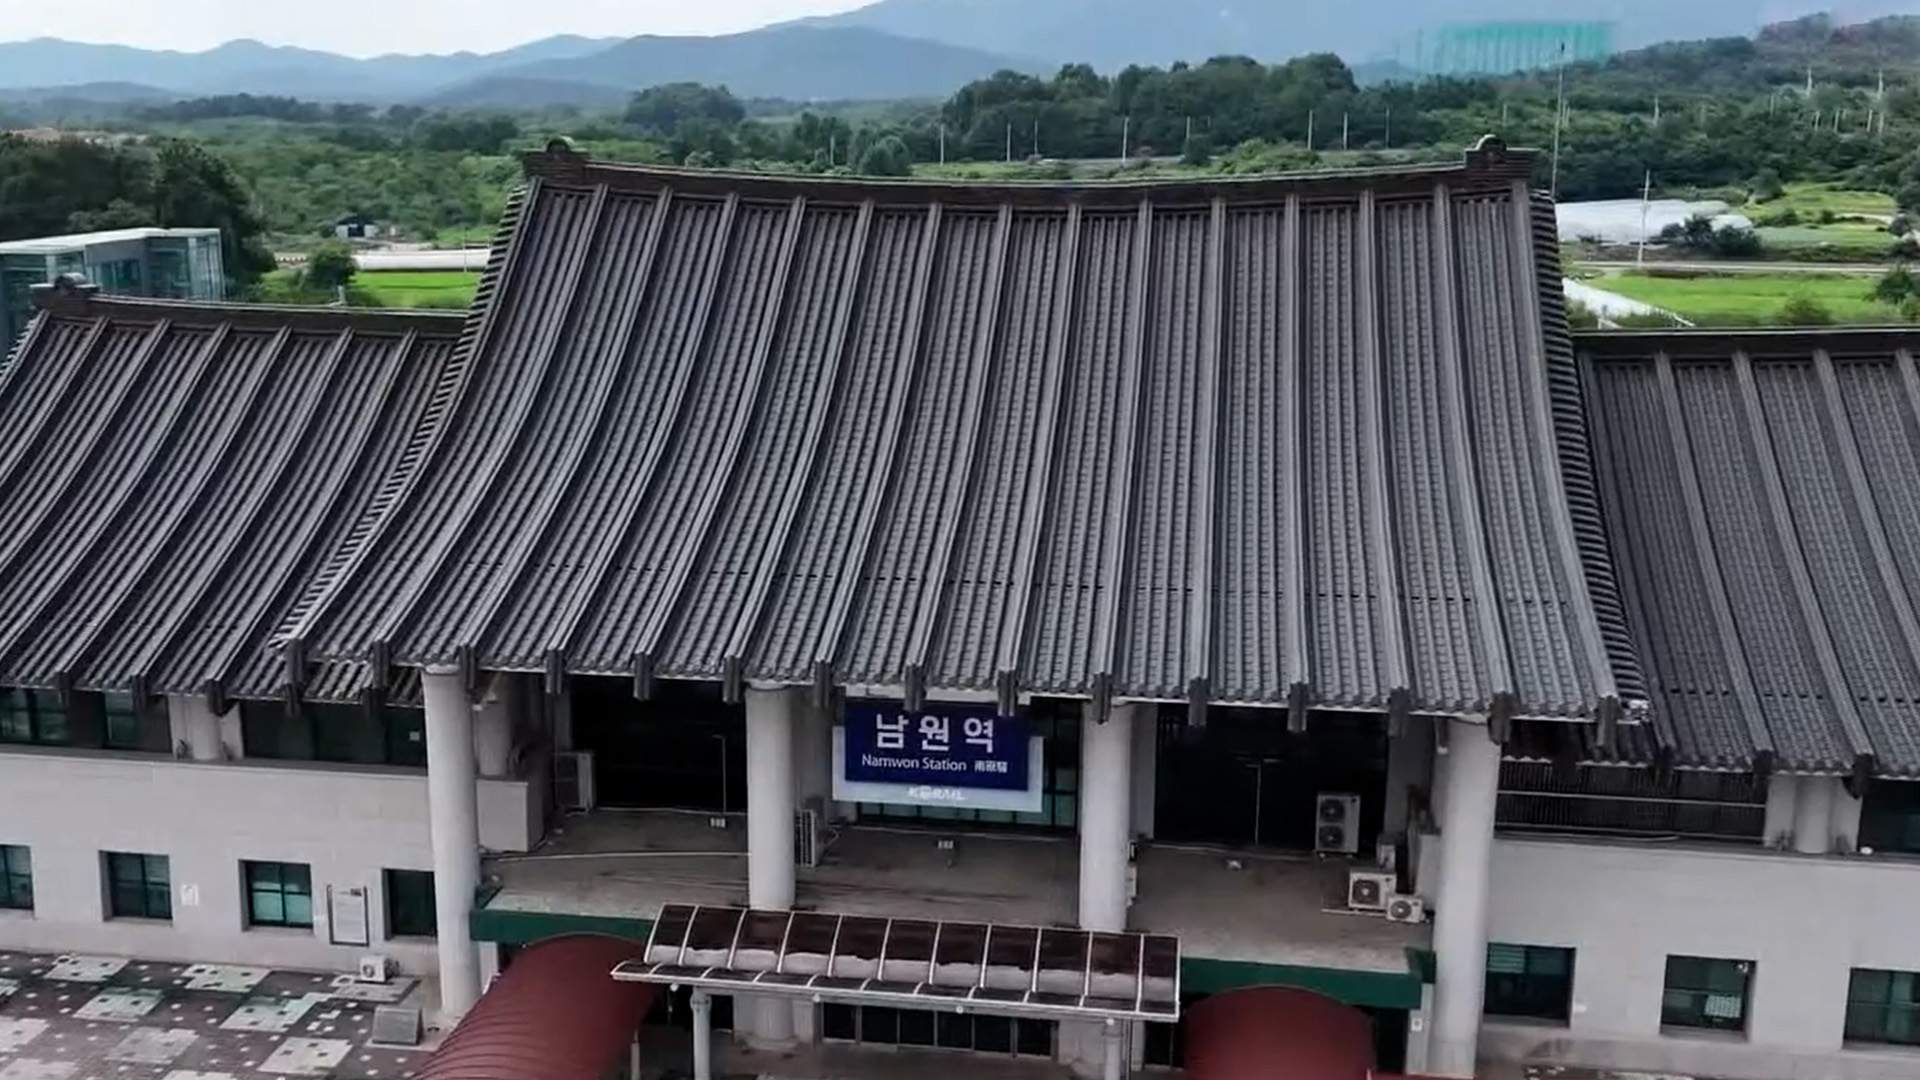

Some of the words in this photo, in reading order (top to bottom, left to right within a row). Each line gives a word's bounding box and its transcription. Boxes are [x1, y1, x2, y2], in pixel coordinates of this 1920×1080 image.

[876, 713, 994, 753] 남원역
[862, 754, 920, 769] Namwon
[922, 756, 967, 772] Station
